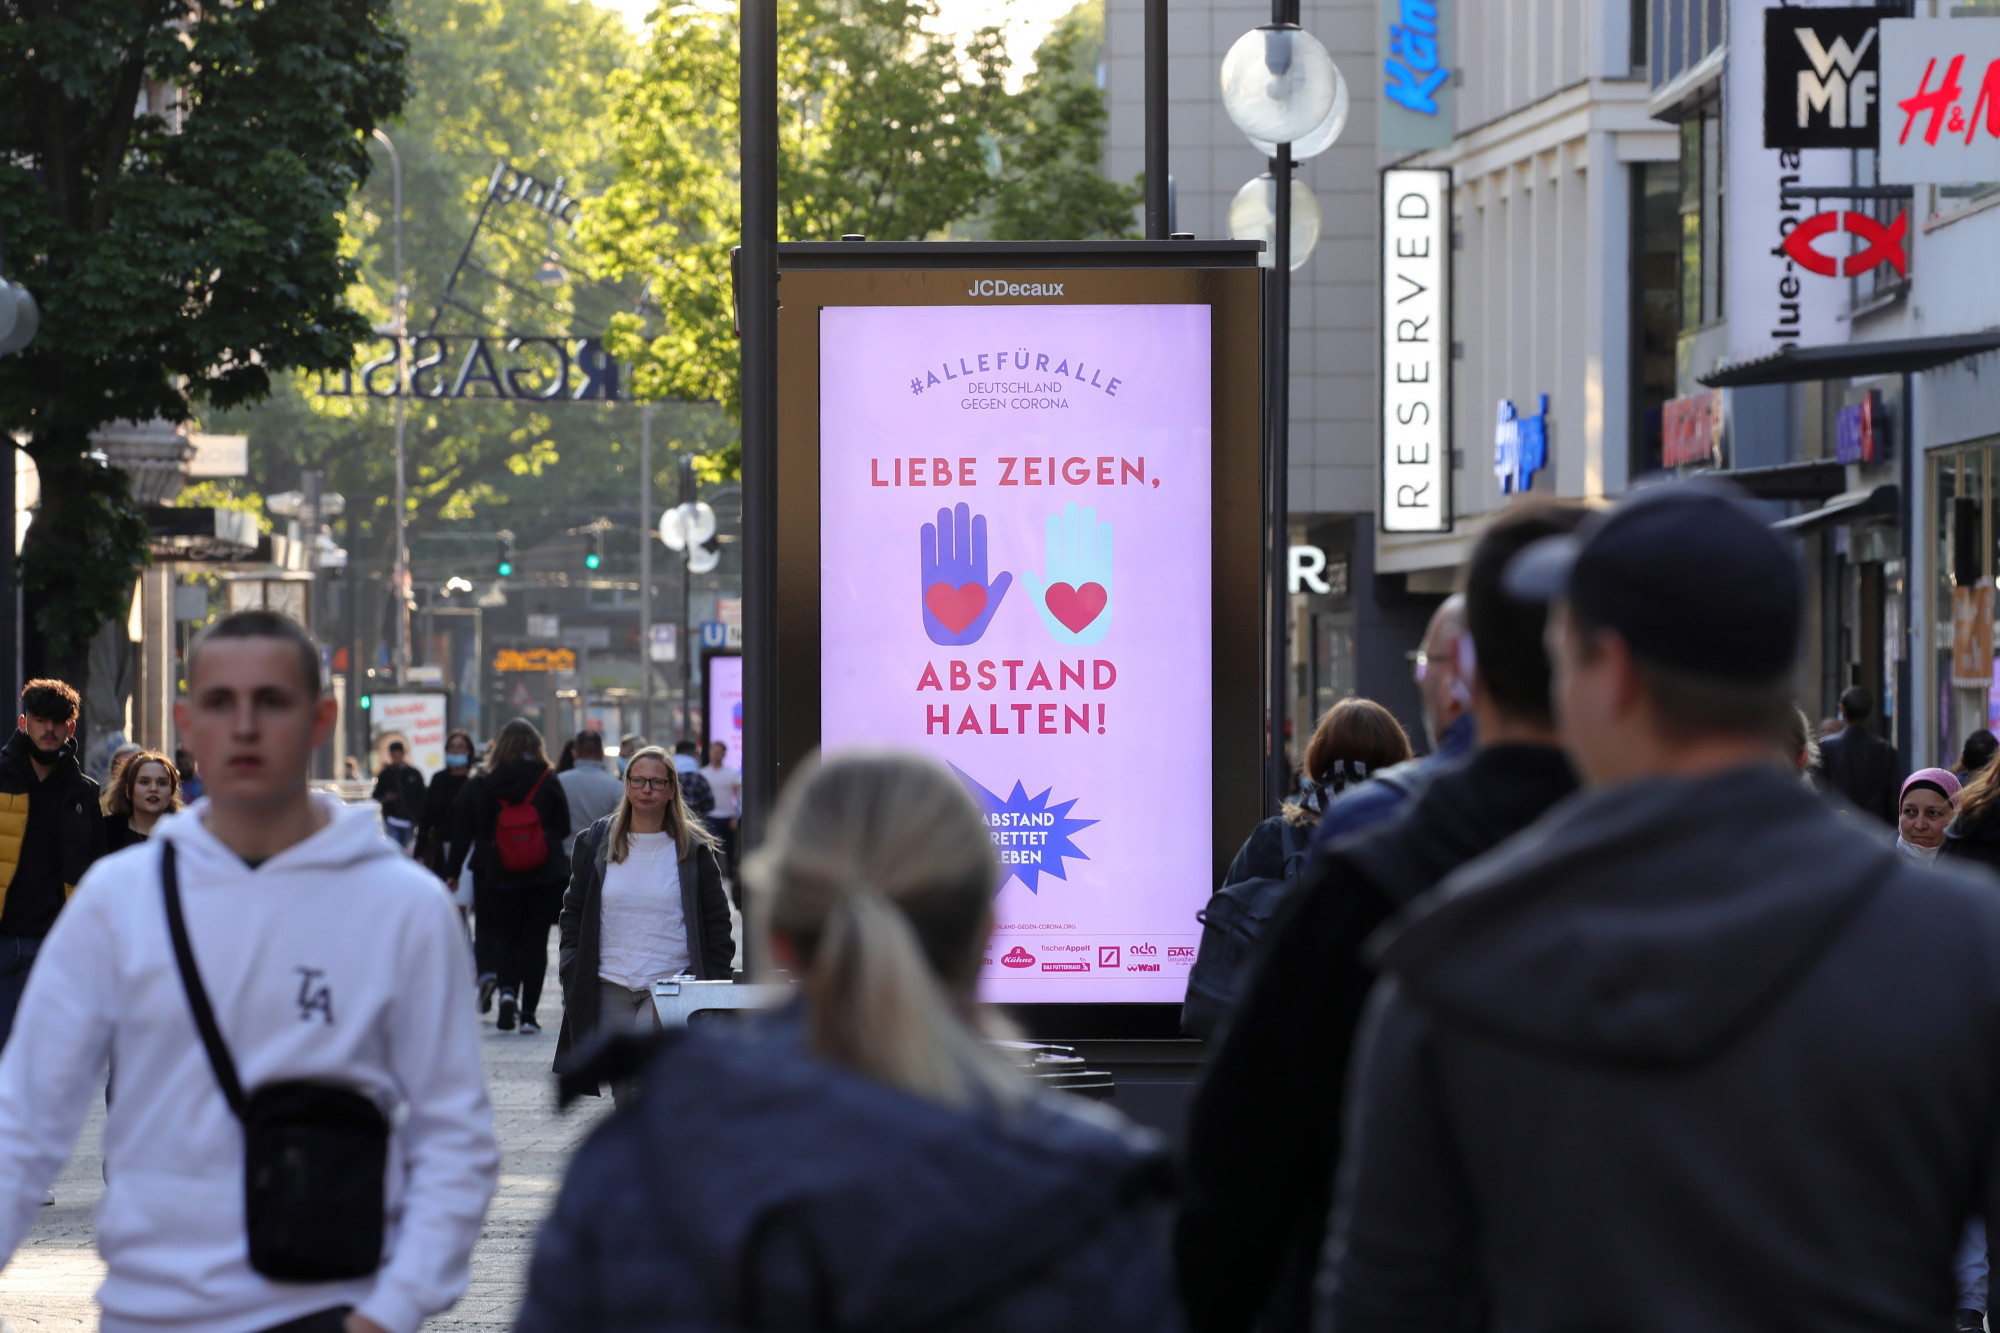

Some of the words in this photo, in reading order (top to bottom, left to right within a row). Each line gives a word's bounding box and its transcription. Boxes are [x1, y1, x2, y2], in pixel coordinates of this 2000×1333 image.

[1794, 27, 1877, 128] WMF
[968, 279, 1064, 297] JCDecaux
[1396, 192, 1429, 508] RESERVED
[910, 347, 1122, 397] #ALLEFÜRALLE
[968, 382, 1062, 394] DEUTSCHLAND
[961, 398, 1007, 410] GEGEN
[1011, 398, 1069, 410] CORONA
[871, 457, 977, 487] LIEBE
[998, 456, 1160, 489] ZEIGEN,
[916, 659, 1117, 691] ABSTAND
[926, 703, 1106, 735] HALTEN!
[982, 812, 1055, 827] ABSTAND
[990, 831, 1049, 846] RETTET
[1003, 956, 1033, 964] Kühne
[1168, 947, 1195, 957] DAK
[1138, 963, 1160, 972] Wall
